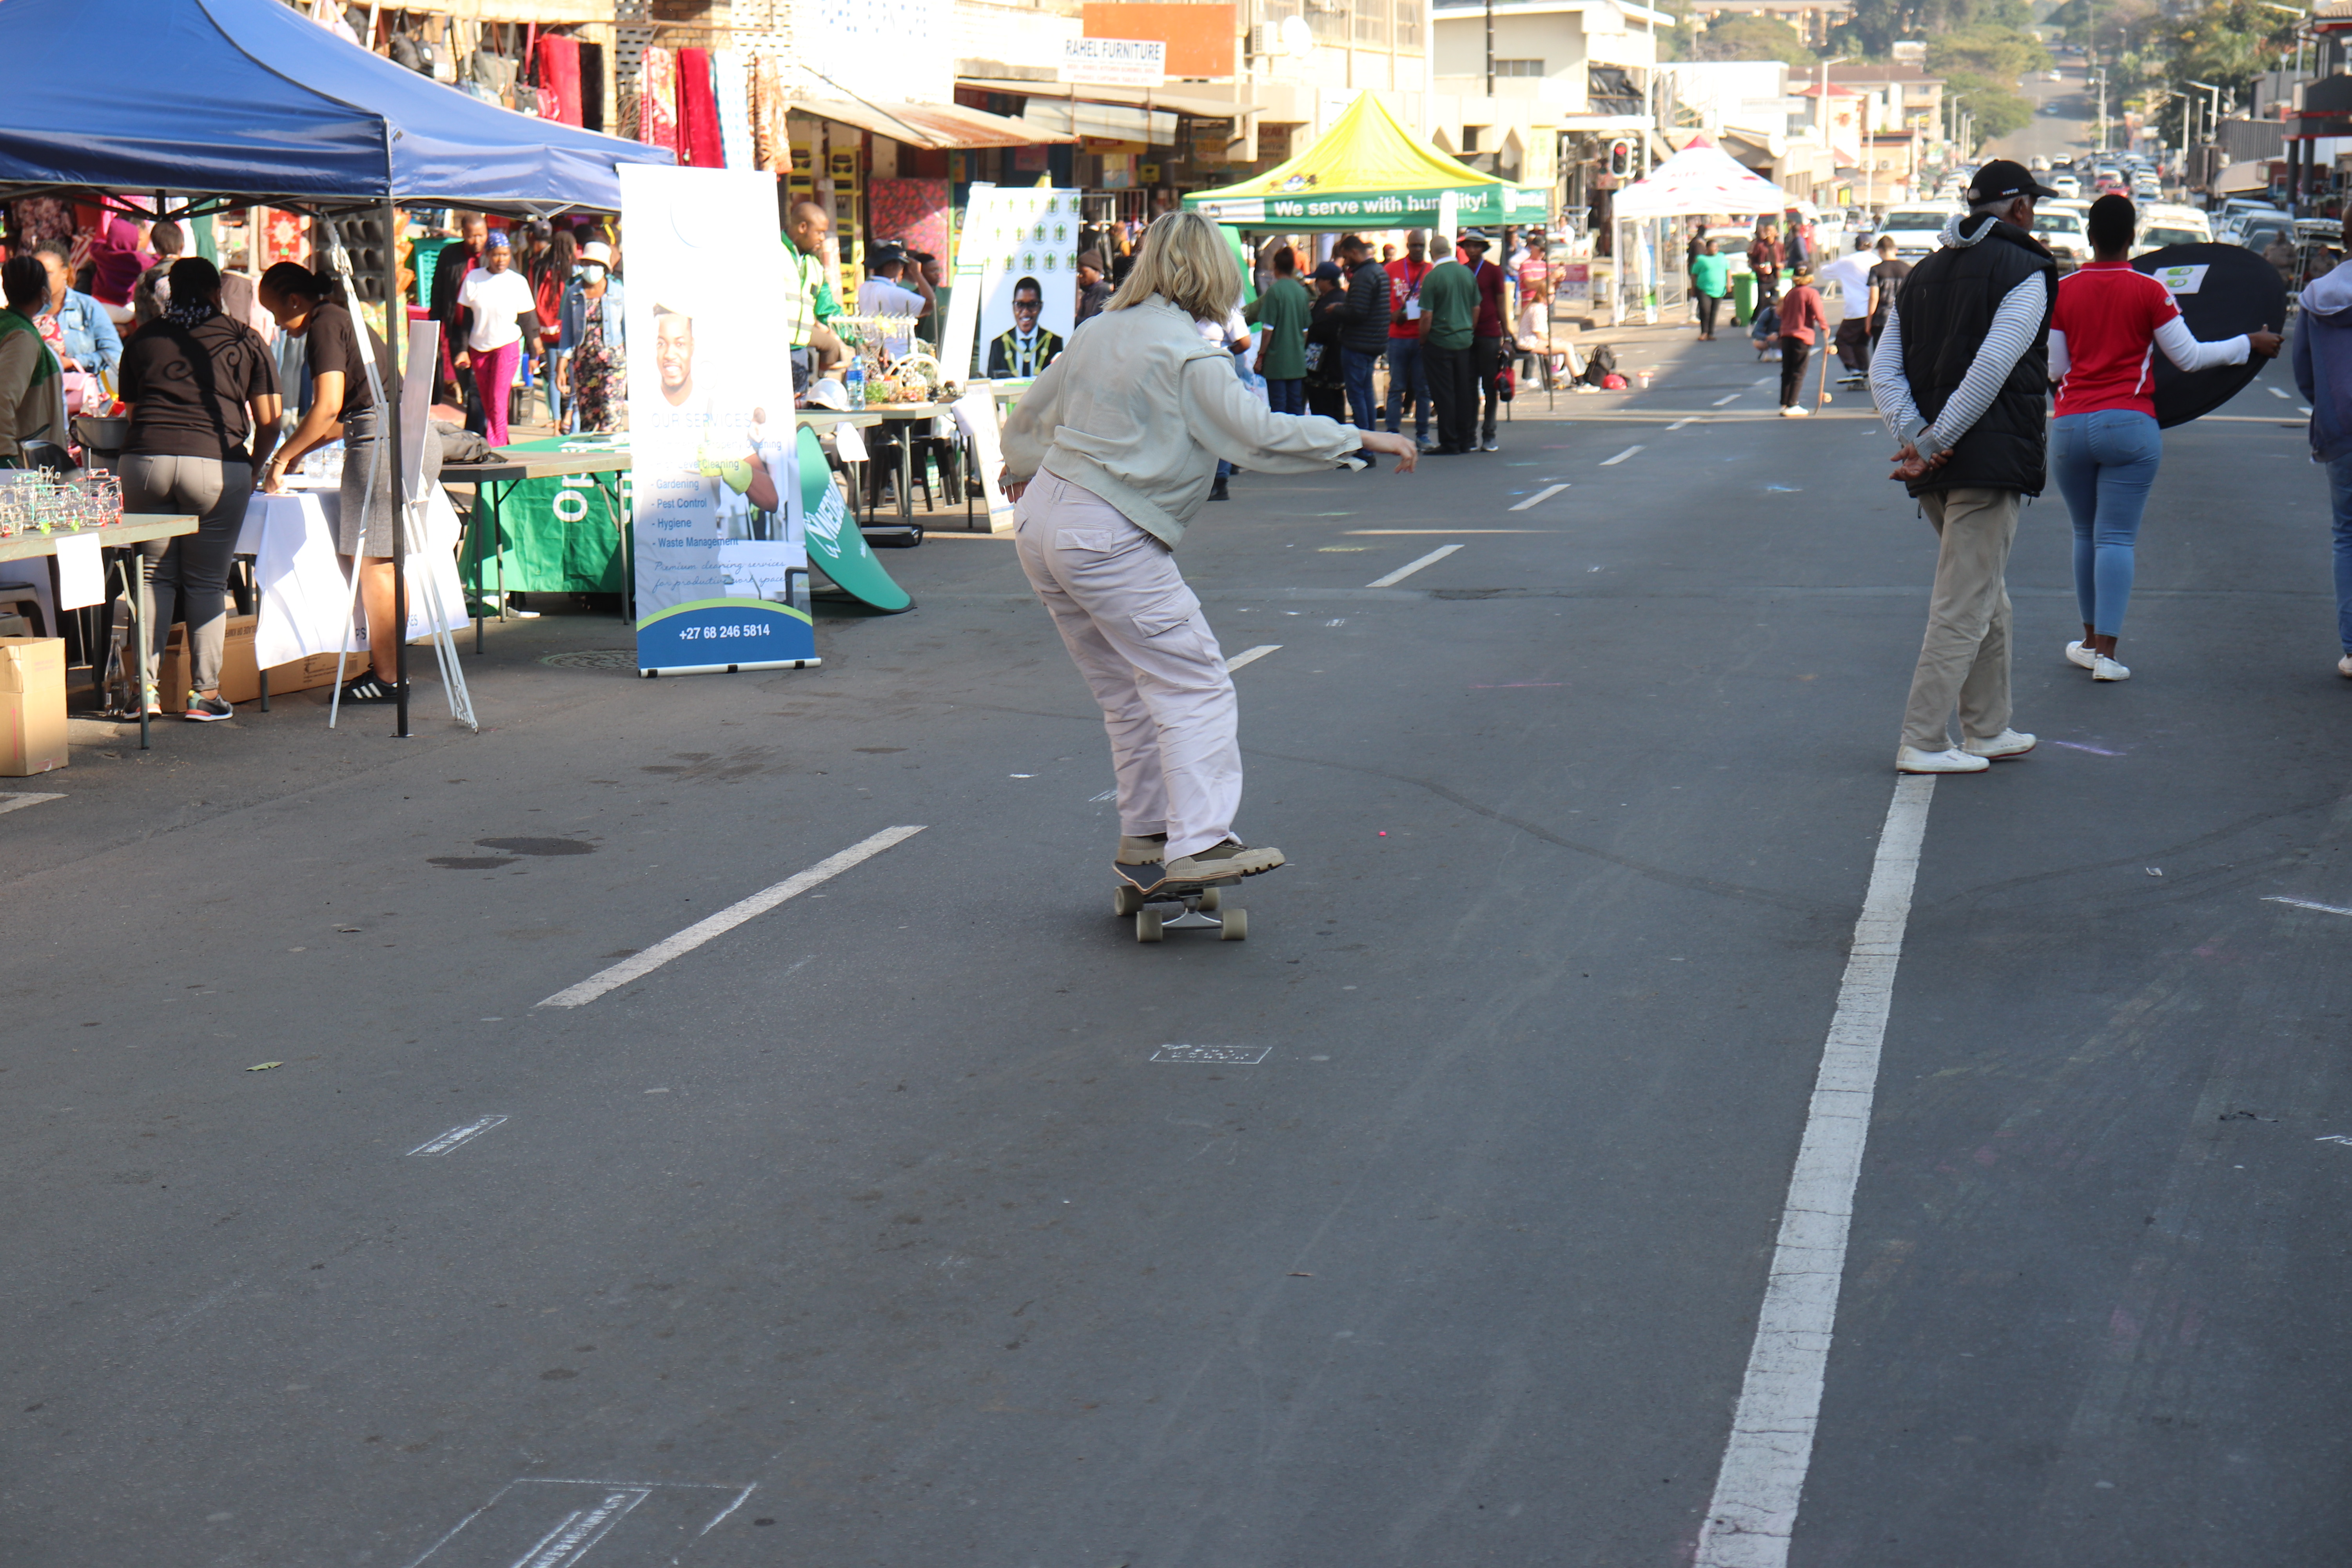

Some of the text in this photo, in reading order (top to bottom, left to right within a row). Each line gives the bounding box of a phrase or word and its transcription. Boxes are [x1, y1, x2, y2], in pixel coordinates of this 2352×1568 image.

[1066, 40, 1161, 60] RAHEL FURNITURE
[1275, 201, 1303, 217] We
[1307, 201, 1359, 216] serve
[1363, 196, 1403, 213] with
[1407, 192, 1488, 212] hulity!
[652, 413, 752, 428] OUR SERVICES
[679, 459, 700, 469] Level
[702, 459, 739, 471] Cleaning
[656, 479, 699, 490] Gardening
[657, 498, 707, 509] Pest Control
[657, 517, 692, 530] Hygiene
[658, 537, 739, 548] Waste Management
[655, 559, 786, 575] Premium cleaning services
[652, 574, 790, 593] for productive work spaces
[679, 623, 770, 640] +27 68 246 5814
